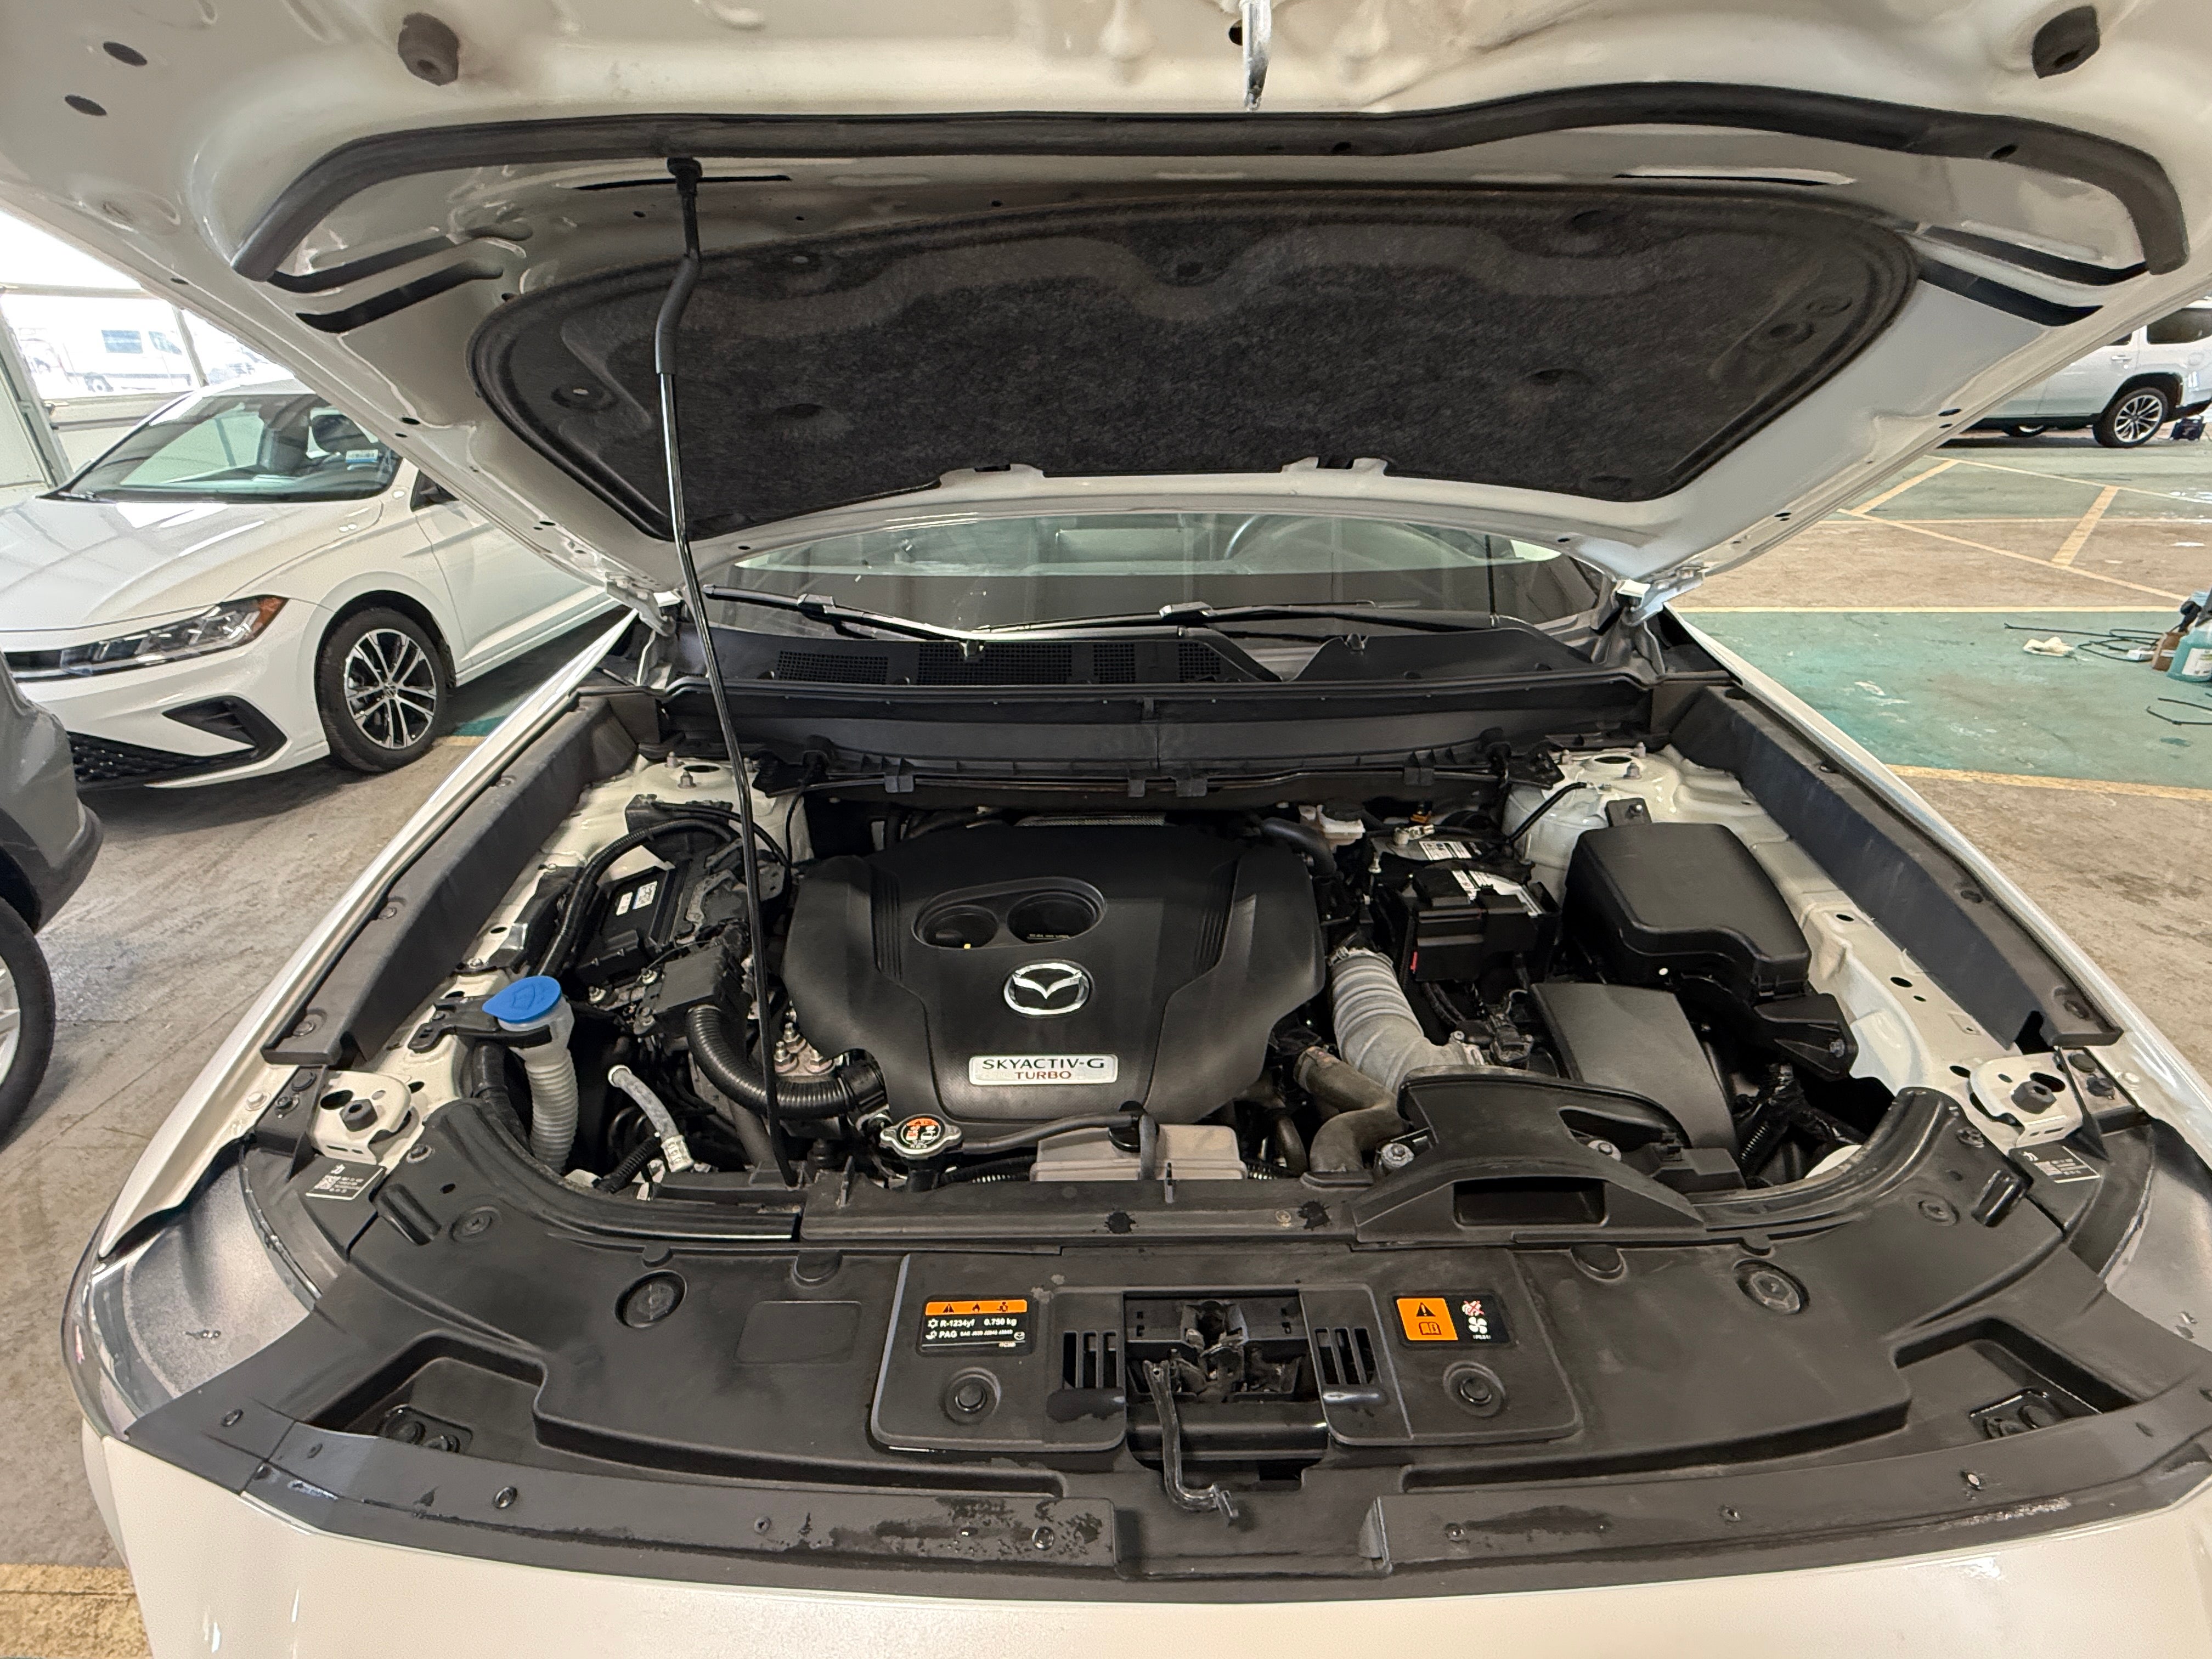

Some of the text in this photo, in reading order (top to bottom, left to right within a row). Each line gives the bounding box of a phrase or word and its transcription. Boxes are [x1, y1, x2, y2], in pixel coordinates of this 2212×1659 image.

[982, 1058, 1105, 1069] SKYACTIV-G
[1015, 1071, 1071, 1080] TURBO
[940, 1318, 975, 1328] R-1234yf
[1006, 1318, 1017, 1326] kg
[939, 1330, 958, 1339] PAG
